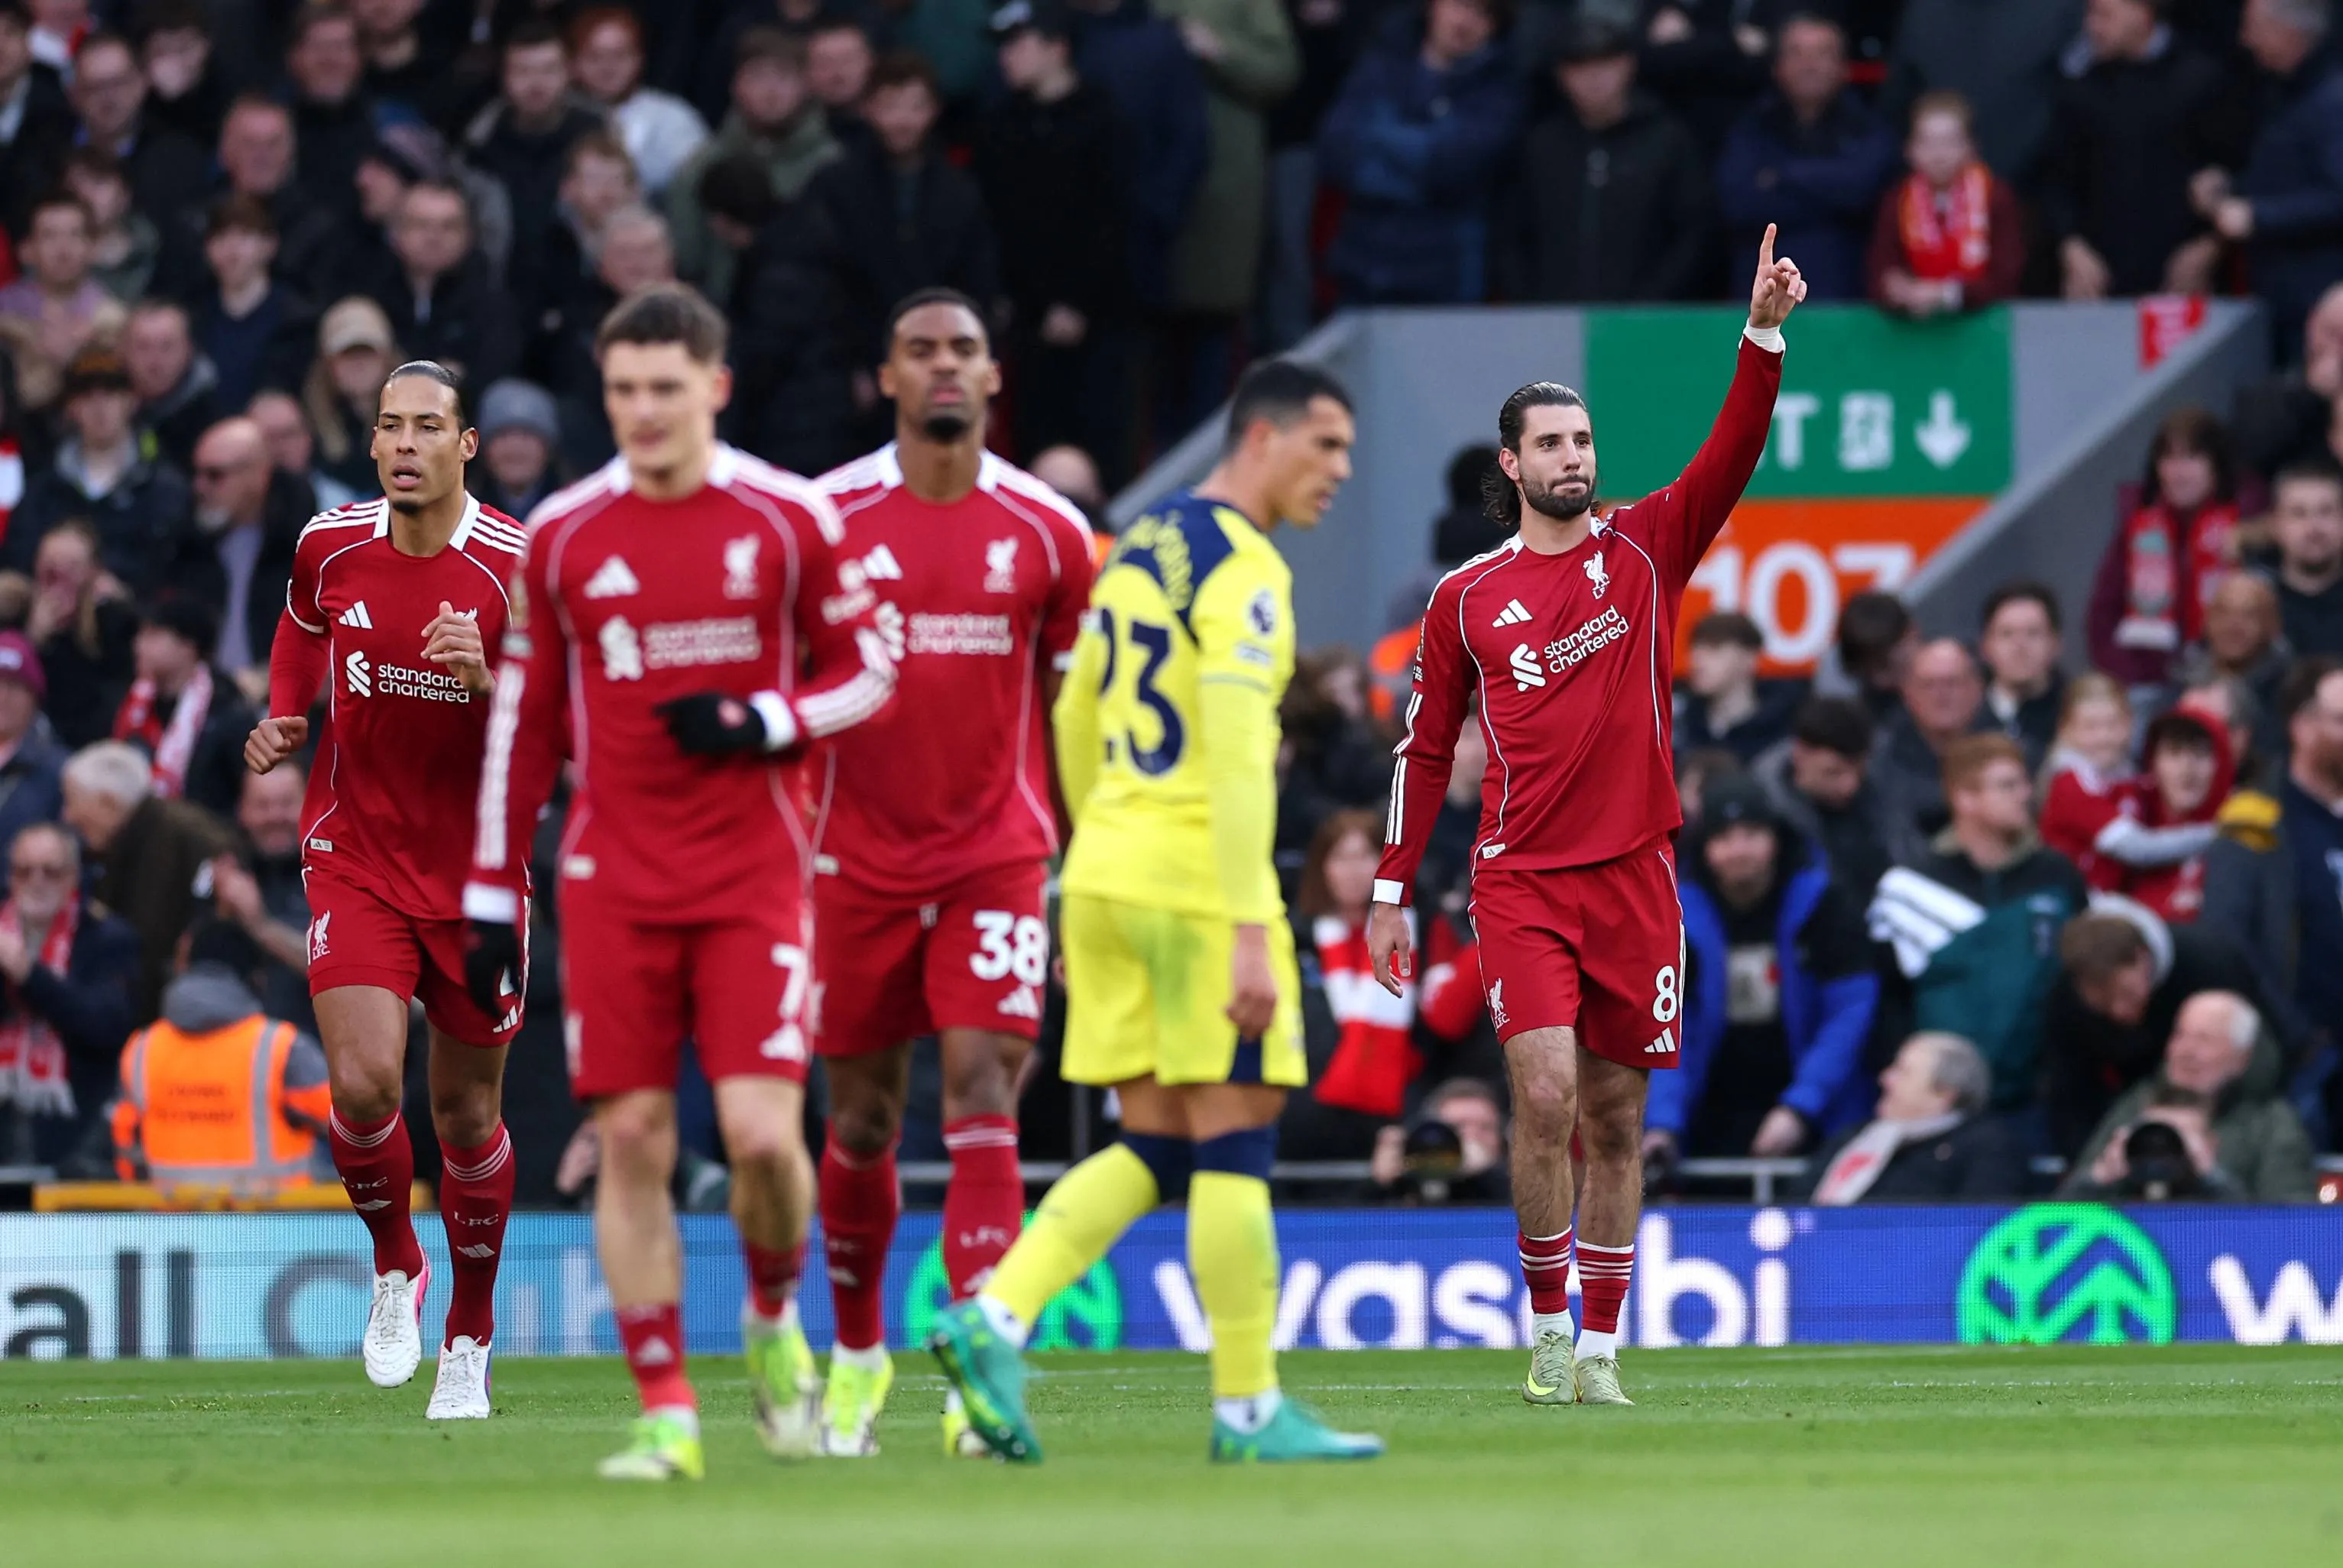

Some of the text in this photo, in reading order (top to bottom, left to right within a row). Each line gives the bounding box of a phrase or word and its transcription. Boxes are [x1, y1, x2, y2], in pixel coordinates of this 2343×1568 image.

[1544, 604, 1619, 659] standard
[1549, 616, 1629, 673] chartered
[378, 679, 470, 703] chartered
[968, 909, 1050, 986] 38
[770, 942, 809, 1019] 7
[1653, 965, 1677, 1022] 8
[454, 1211, 499, 1226] LFC
